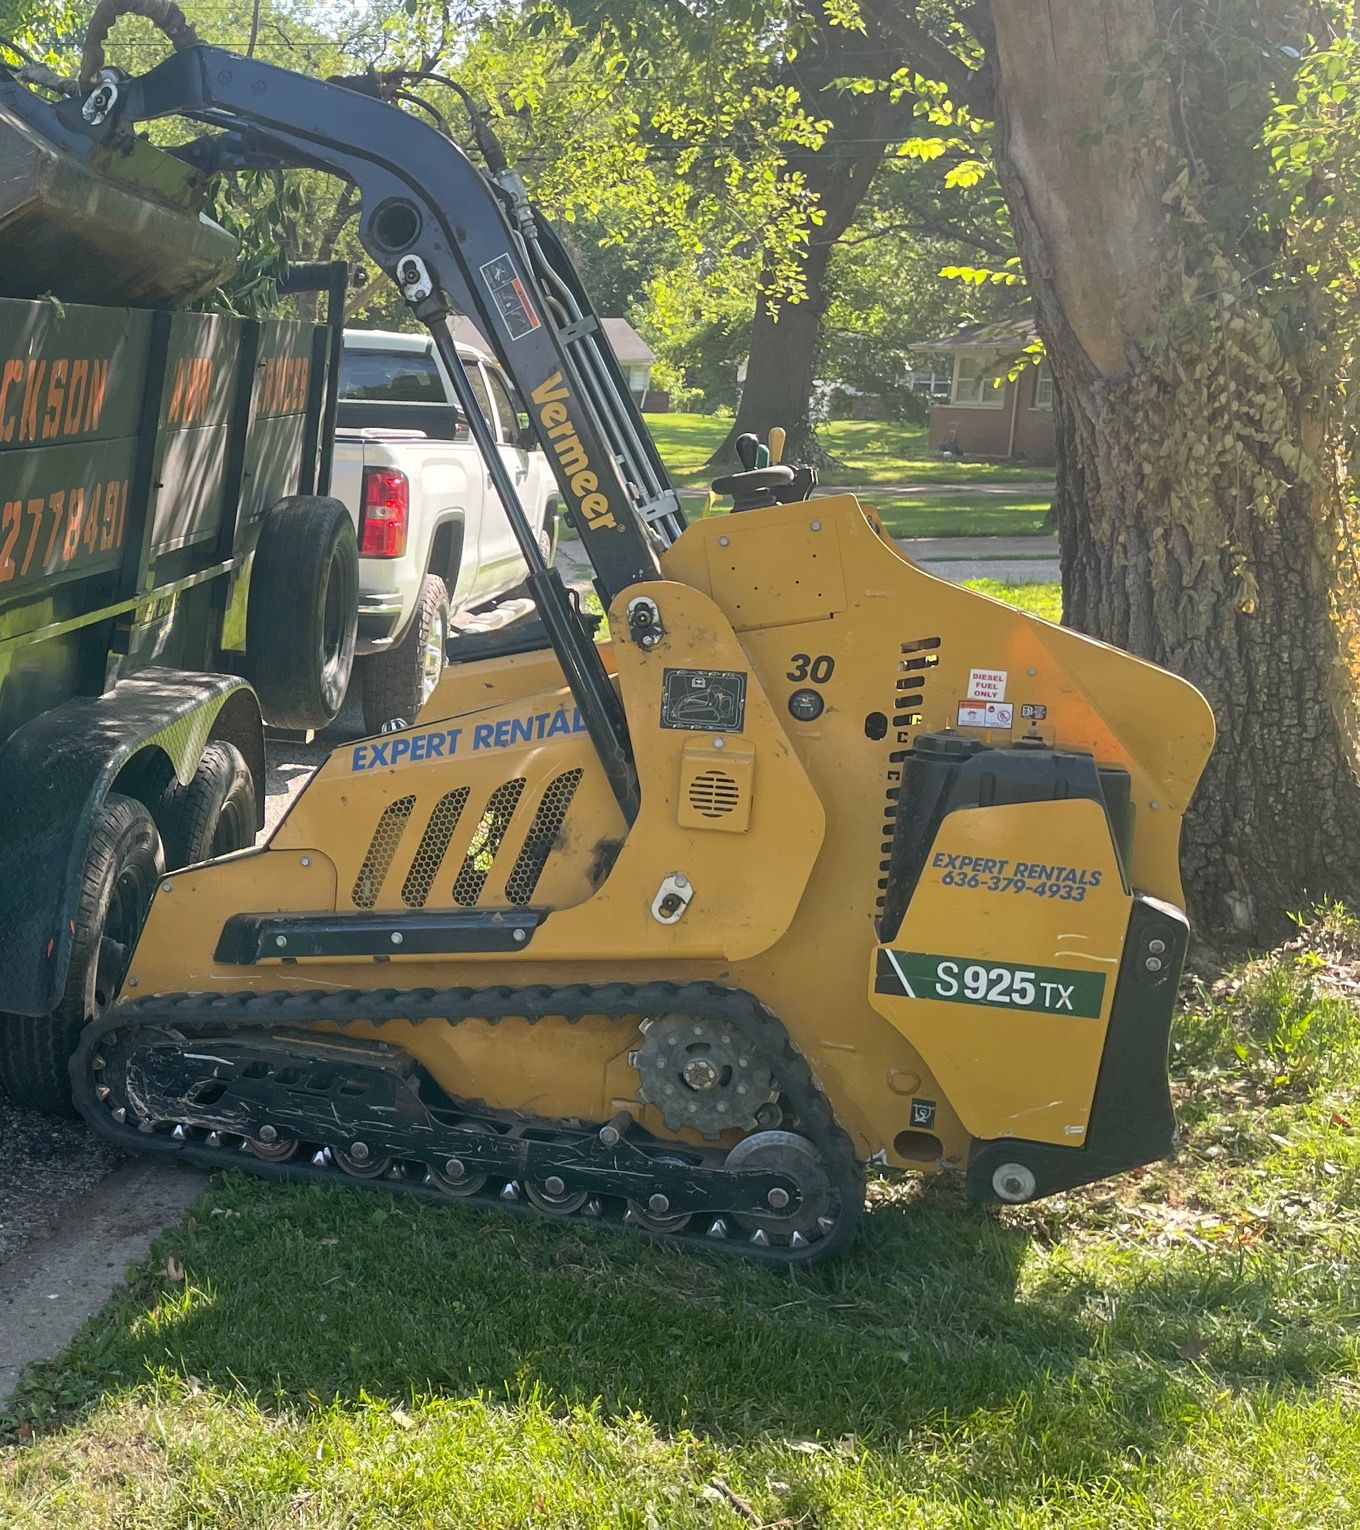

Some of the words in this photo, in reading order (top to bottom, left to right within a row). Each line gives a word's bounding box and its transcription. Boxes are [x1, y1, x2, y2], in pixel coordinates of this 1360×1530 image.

[530, 370, 617, 532] Vermeer
[786, 653, 835, 684] 30
[972, 673, 1004, 682] DIESEL
[974, 690, 998, 698] ONLY
[975, 682, 998, 690] FUEL
[352, 728, 463, 771] EXPERT
[473, 708, 588, 750] RENTAL
[932, 853, 1008, 875] EXPERT
[1013, 862, 1103, 886] RENTALS
[942, 870, 1086, 902] 636-379-4933
